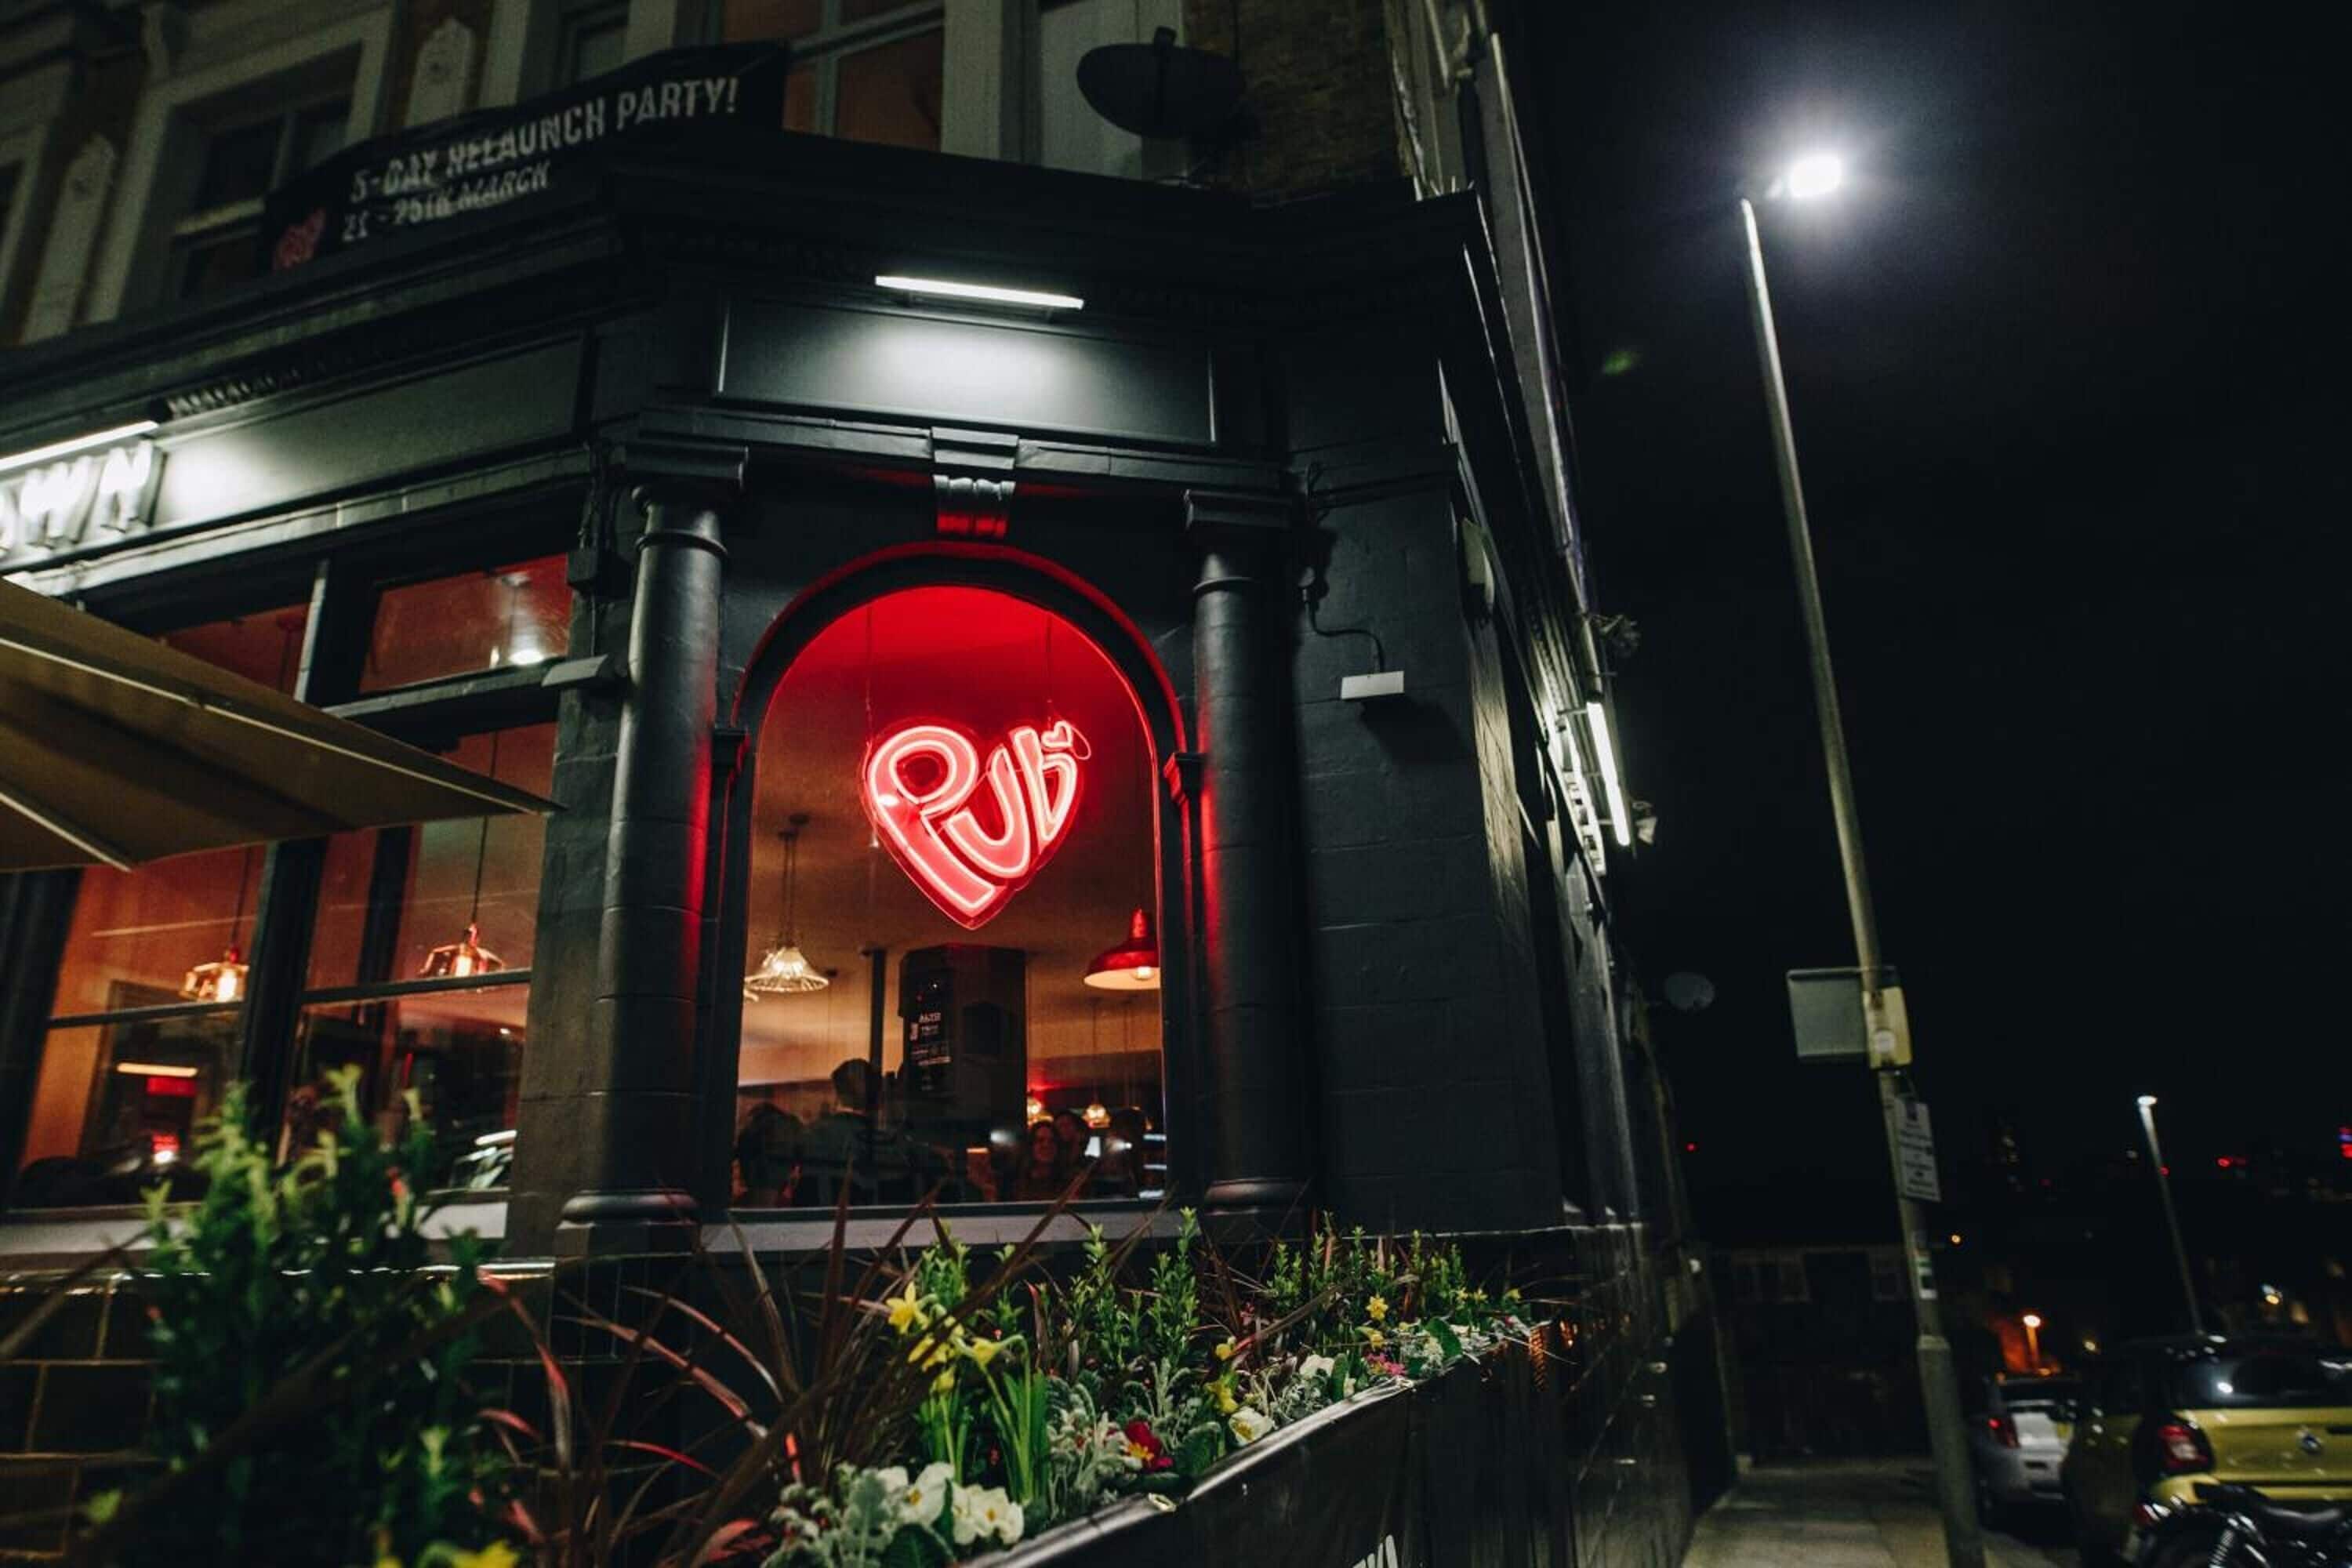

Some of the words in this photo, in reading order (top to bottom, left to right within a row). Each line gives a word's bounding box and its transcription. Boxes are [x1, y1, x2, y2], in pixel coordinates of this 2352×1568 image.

[350, 150, 437, 203] 5-DAY
[445, 97, 606, 178] RELAUNCH
[616, 77, 739, 131] PARTY!
[458, 160, 551, 211] MARCH
